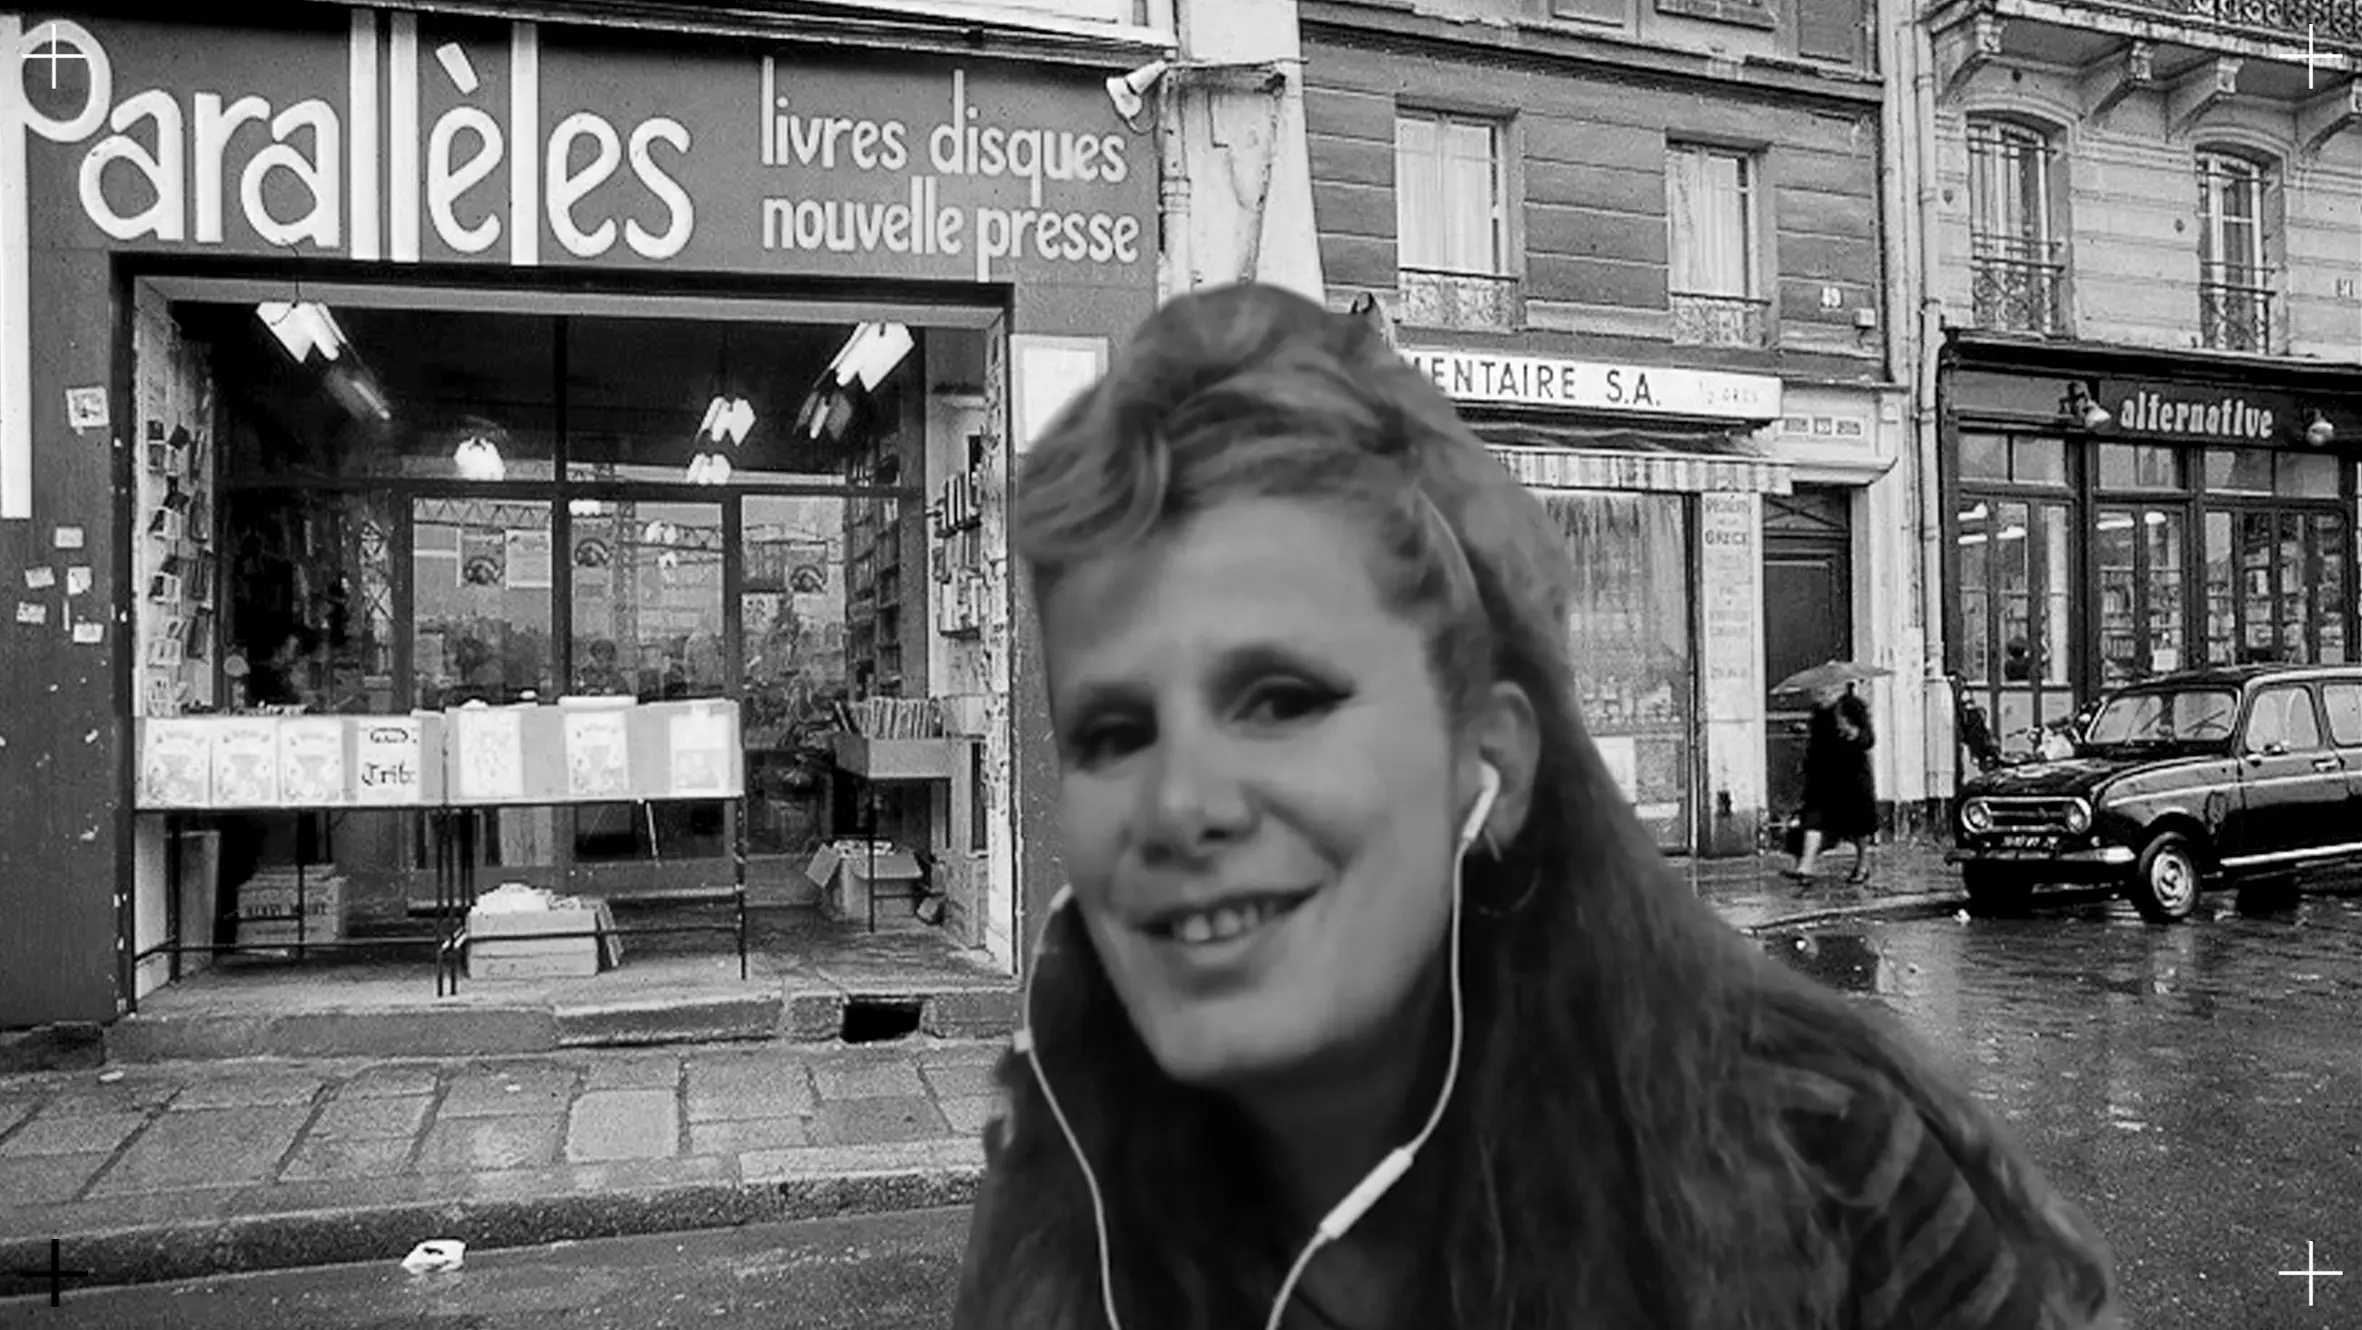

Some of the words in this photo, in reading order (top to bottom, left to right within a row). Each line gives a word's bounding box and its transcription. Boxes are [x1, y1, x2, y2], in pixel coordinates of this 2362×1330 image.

[761, 57, 908, 170] livres
[929, 69, 1128, 208] disques
[763, 176, 964, 255] nouvelle
[976, 207, 1139, 283] presse
[1413, 355, 1577, 400] ENTAIRE
[1606, 369, 1661, 406] S.A.
[2120, 390, 2274, 440] alternative
